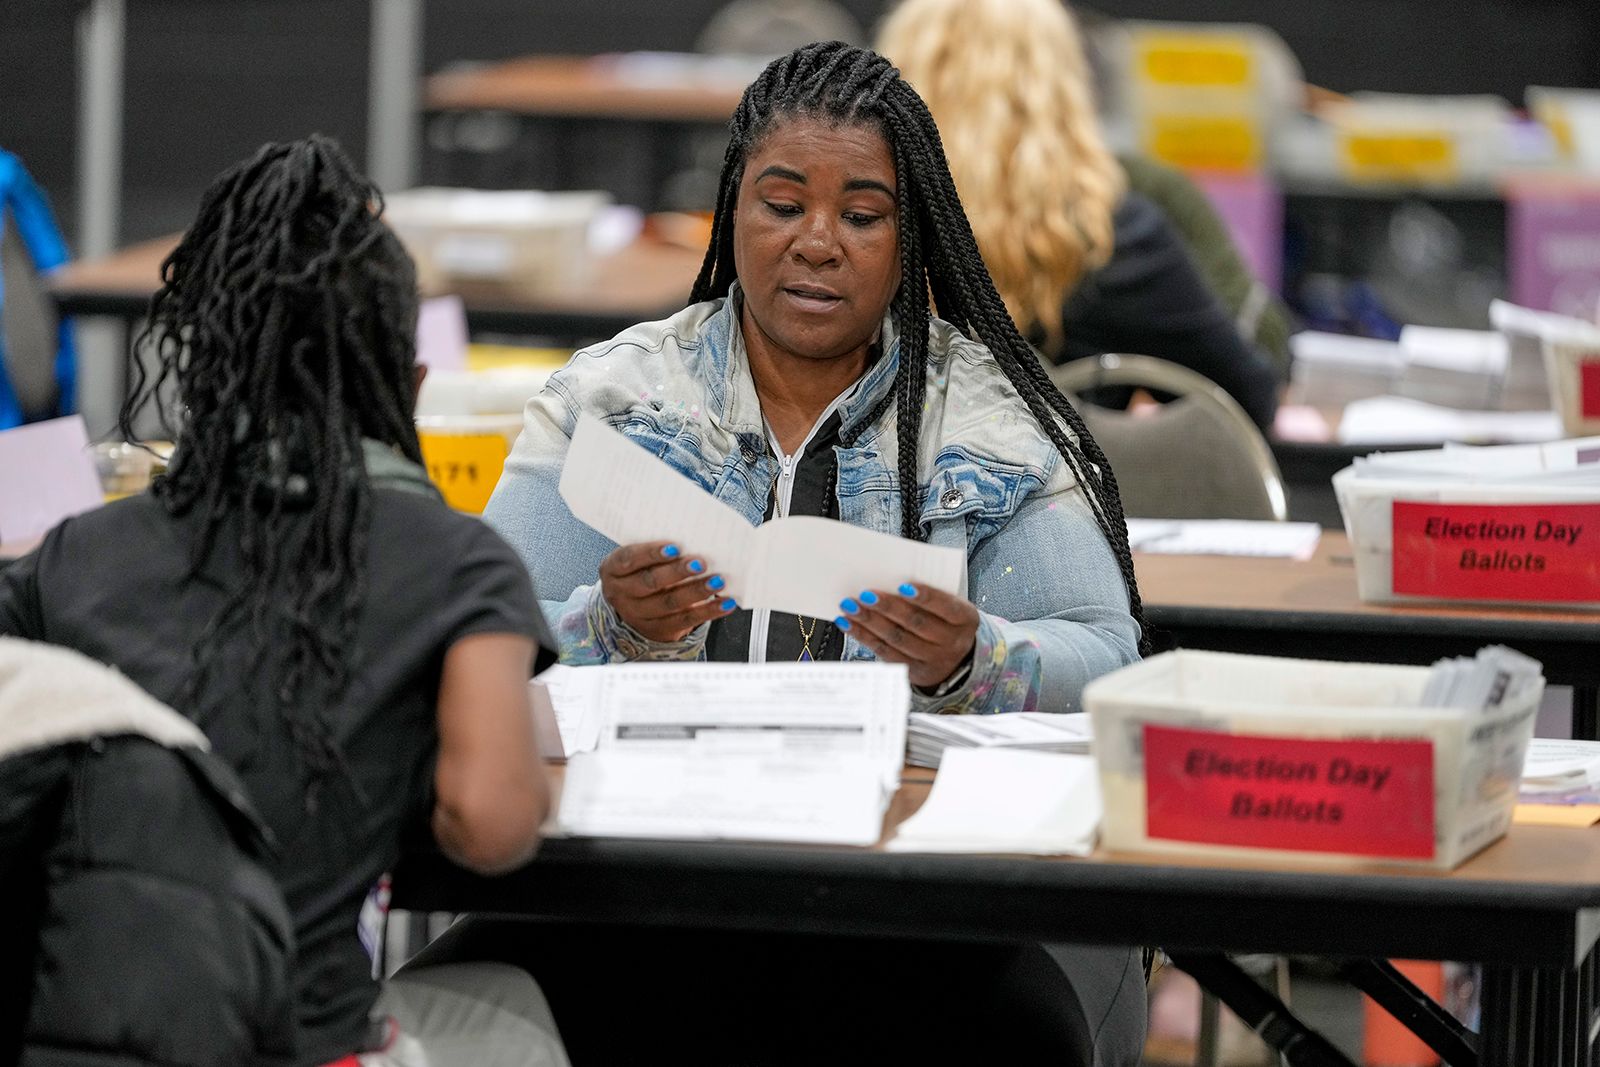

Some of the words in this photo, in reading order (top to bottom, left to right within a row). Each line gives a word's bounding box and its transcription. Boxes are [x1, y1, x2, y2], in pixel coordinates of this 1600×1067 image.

[1424, 516, 1526, 541] Election
[1534, 519, 1583, 545] Day
[1459, 548, 1546, 572] Ballots
[1184, 748, 1318, 783] Election
[1326, 757, 1391, 791] Day
[1230, 791, 1344, 825] Ballots
